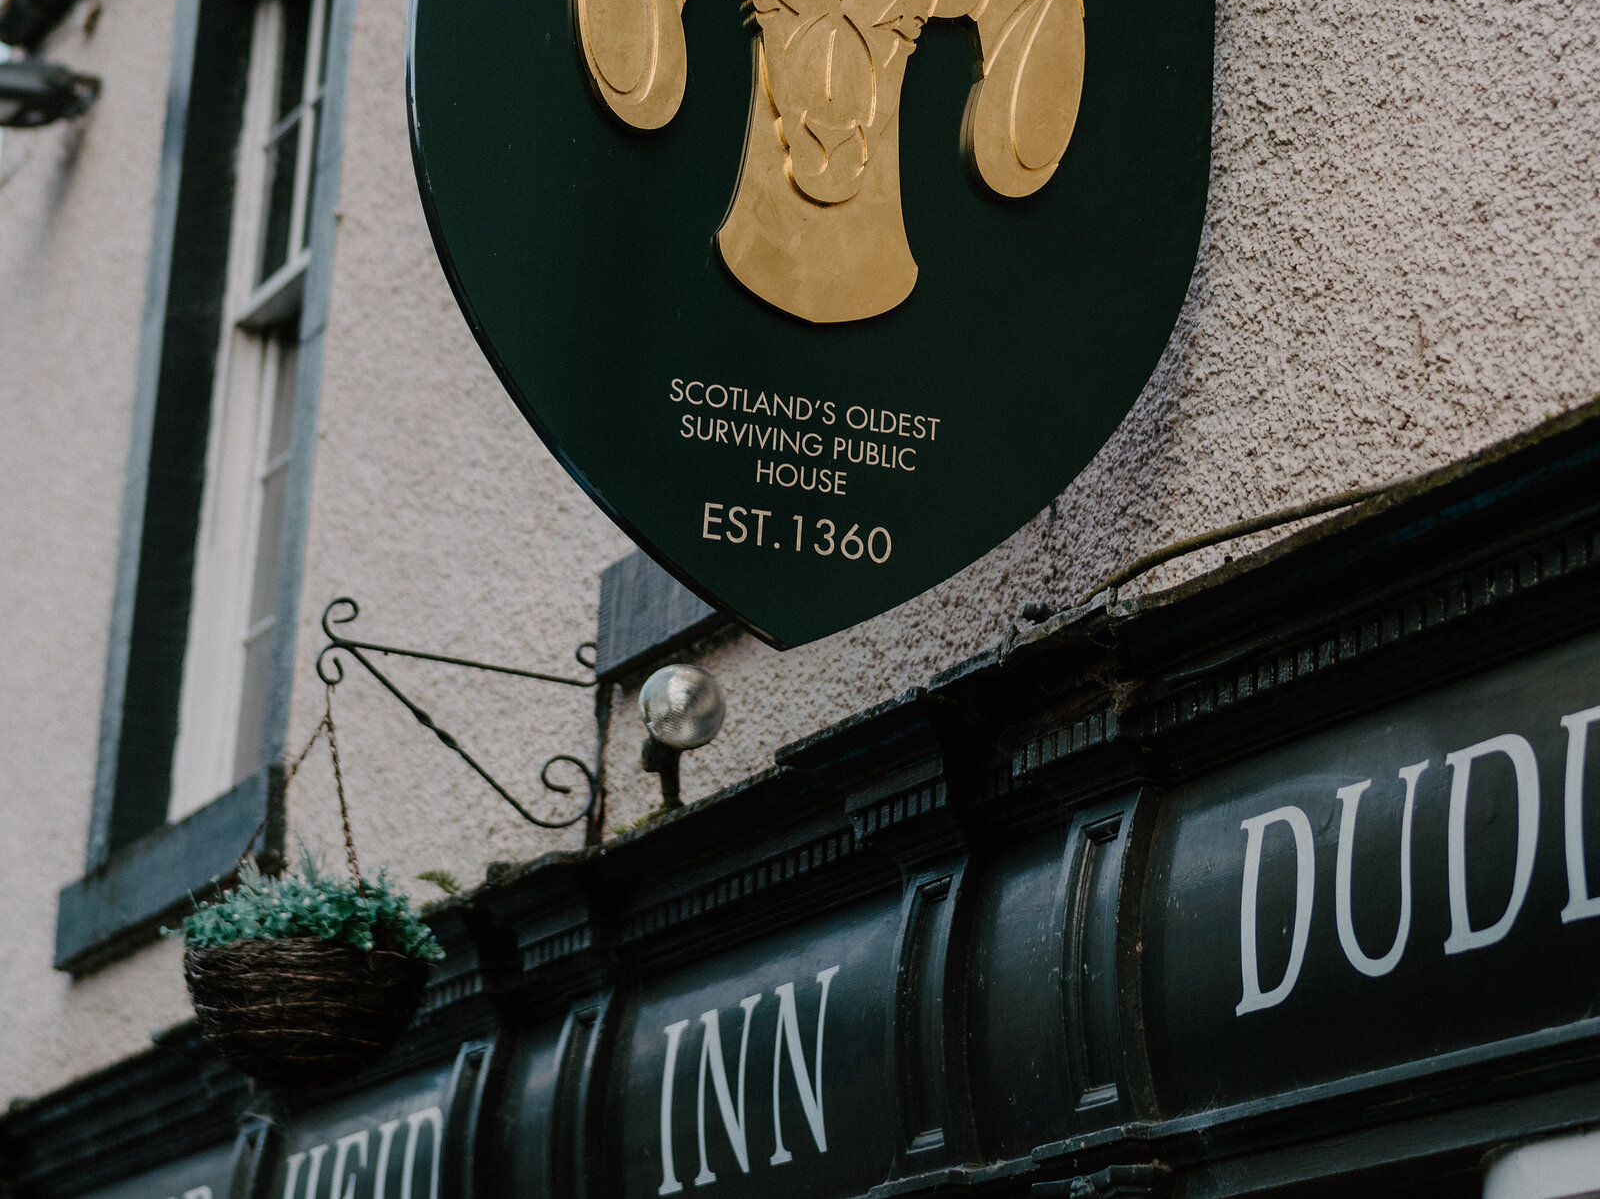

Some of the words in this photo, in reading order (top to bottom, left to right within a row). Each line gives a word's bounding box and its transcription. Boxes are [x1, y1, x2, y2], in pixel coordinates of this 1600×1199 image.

[669, 378, 836, 425] SCOTLAND'S
[846, 405, 940, 441] OLDEST
[680, 414, 823, 457] SURVIVING
[833, 436, 917, 472] PUBLIC
[756, 459, 847, 496] HOUSE
[657, 965, 840, 1196] INN
